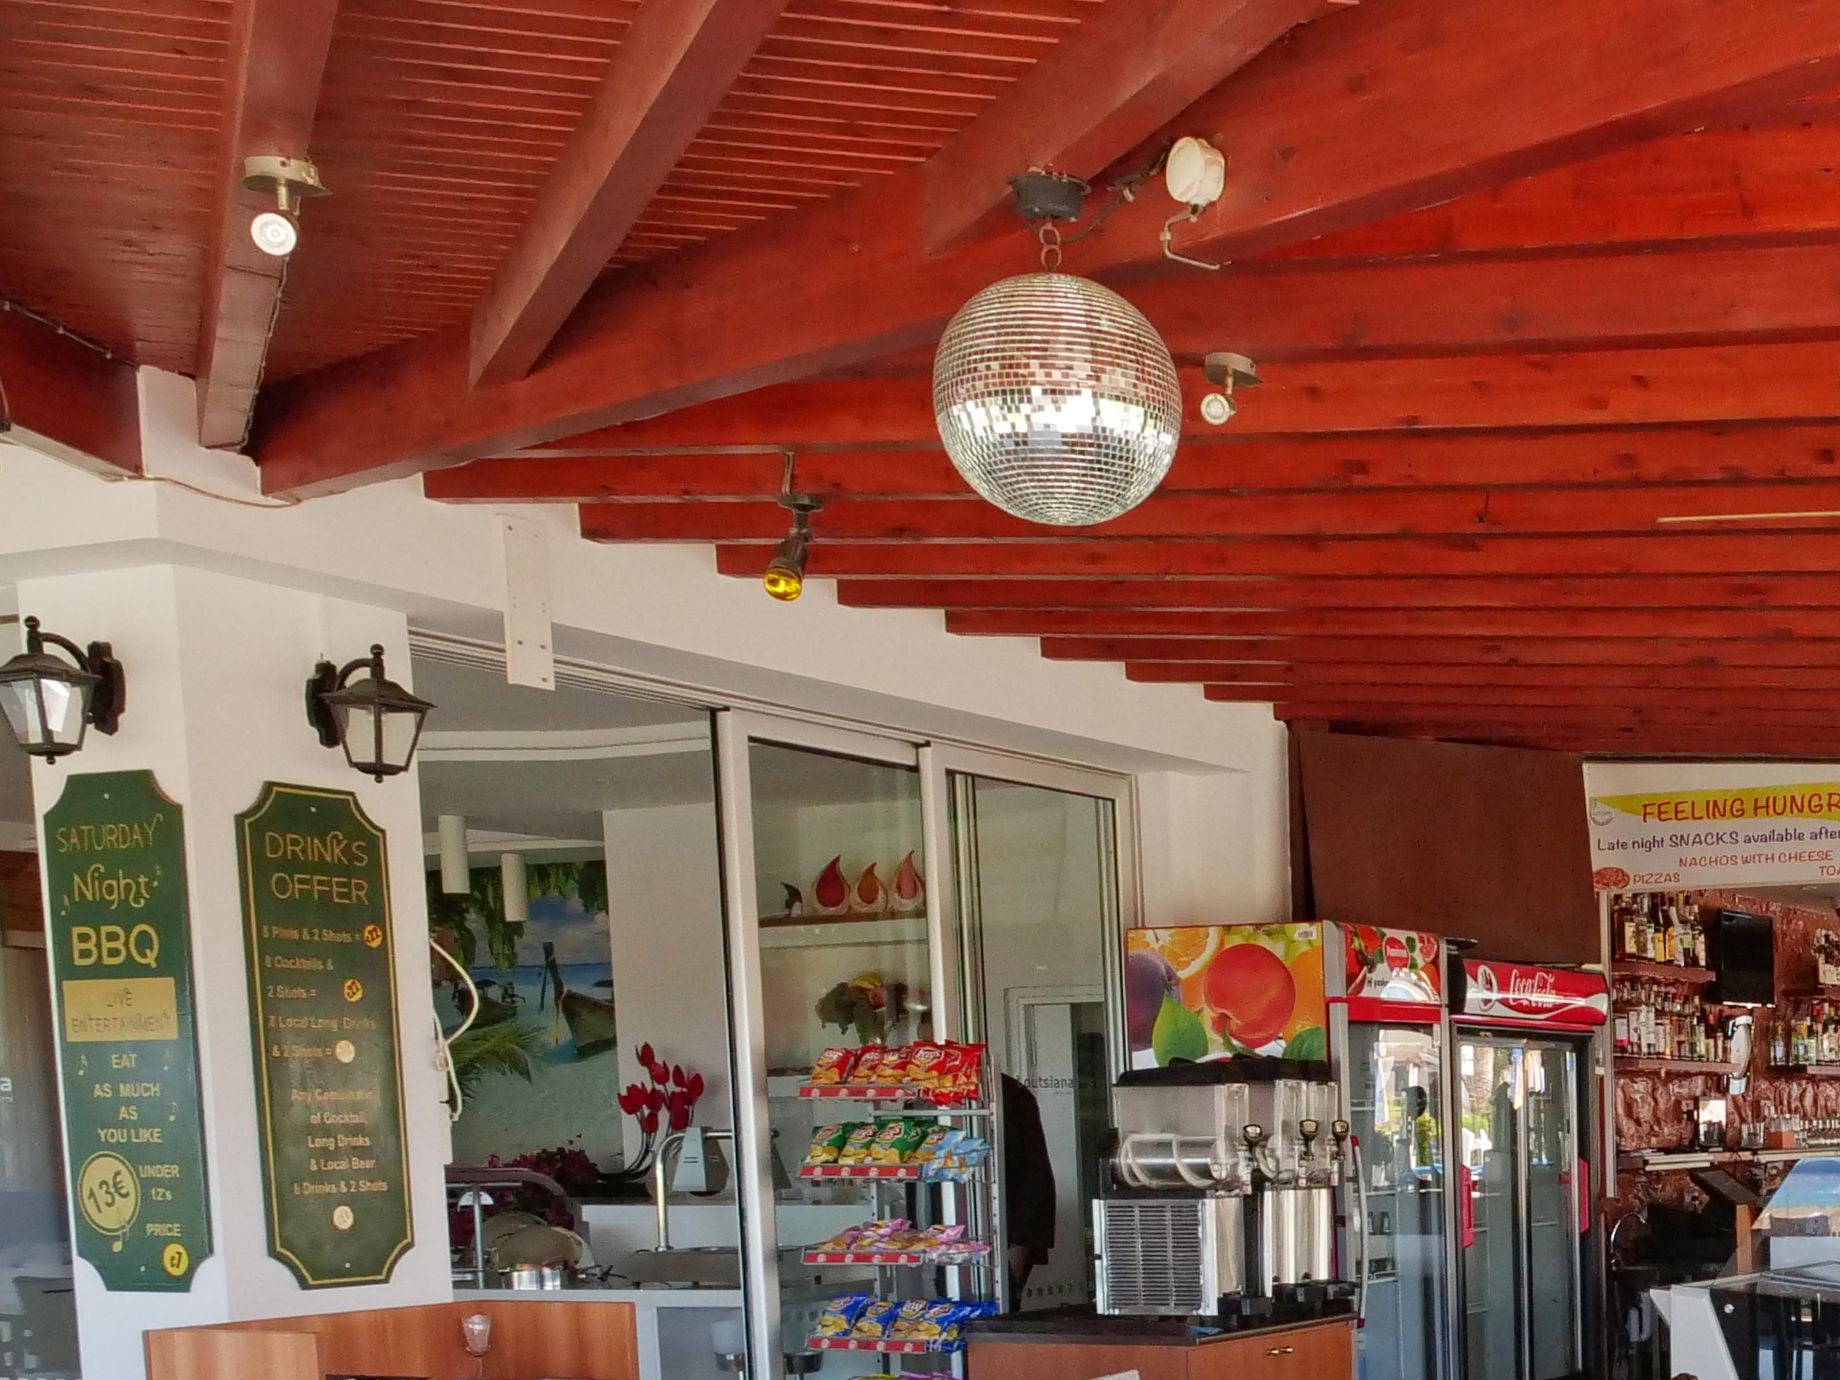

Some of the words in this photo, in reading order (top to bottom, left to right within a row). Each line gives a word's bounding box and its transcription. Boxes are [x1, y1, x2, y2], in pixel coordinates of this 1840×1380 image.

[1641, 796, 1746, 824] FEELING
[56, 813, 164, 853] SATURDAY
[1597, 838, 1629, 851] Late
[1631, 836, 1665, 853] night
[1668, 830, 1739, 848] SNACKS
[1743, 827, 1806, 845] available
[264, 830, 369, 867] DRINKS
[1678, 854, 1738, 868] NACHOS
[1741, 852, 1775, 866] WITH
[1778, 850, 1834, 863] CHEESE
[73, 863, 151, 910] Night
[1632, 872, 1681, 885] PIZZAS
[271, 872, 369, 906] OFFER
[71, 923, 160, 969] BBQ
[266, 985, 275, 998] 2
[111, 1053, 138, 1069] EAT
[93, 1083, 113, 1098] AS
[119, 1082, 160, 1097] MUCH
[118, 1105, 138, 1121] AS
[97, 1128, 128, 1143] YOU
[131, 1128, 163, 1143] LIKE
[307, 1135, 335, 1150] Long
[138, 1164, 181, 1178] UNDER
[87, 1169, 130, 1214] 13€
[350, 1180, 358, 1193] 2
[145, 1223, 182, 1238] PRICE
